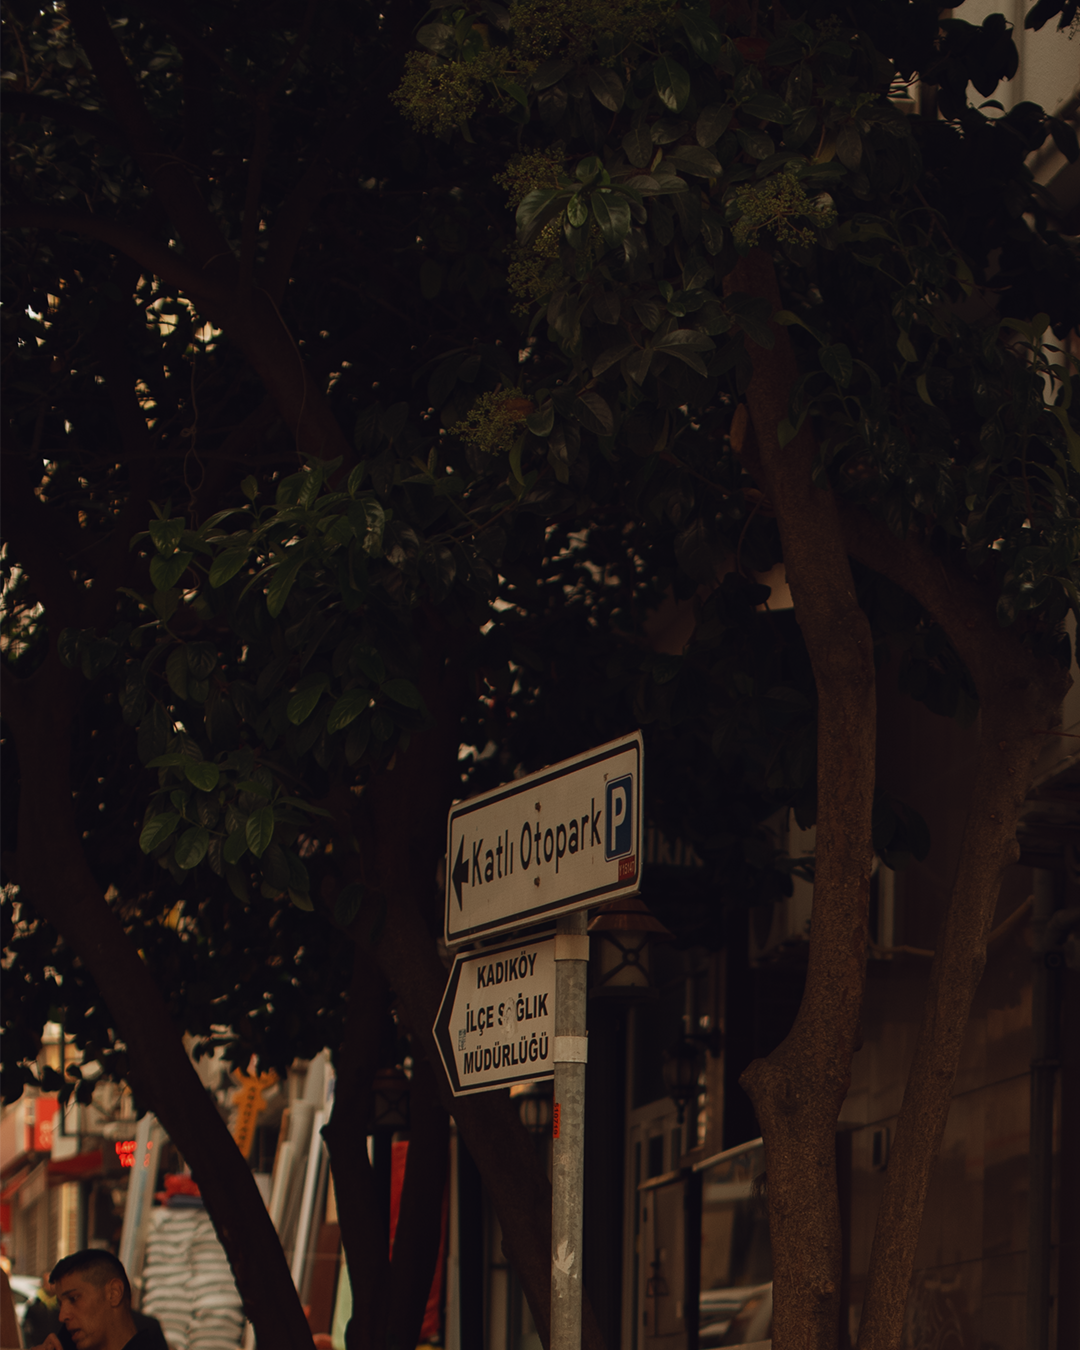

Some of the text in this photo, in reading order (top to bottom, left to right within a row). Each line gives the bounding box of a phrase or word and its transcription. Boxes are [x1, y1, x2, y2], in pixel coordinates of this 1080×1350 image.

[472, 829, 514, 887] Katlı
[520, 798, 603, 874] Otopark
[477, 951, 538, 989] KADIKÖY
[465, 993, 549, 1036] İLÇE SĞLIK
[463, 1033, 550, 1075] MÜDÜRLÜĞÜ
